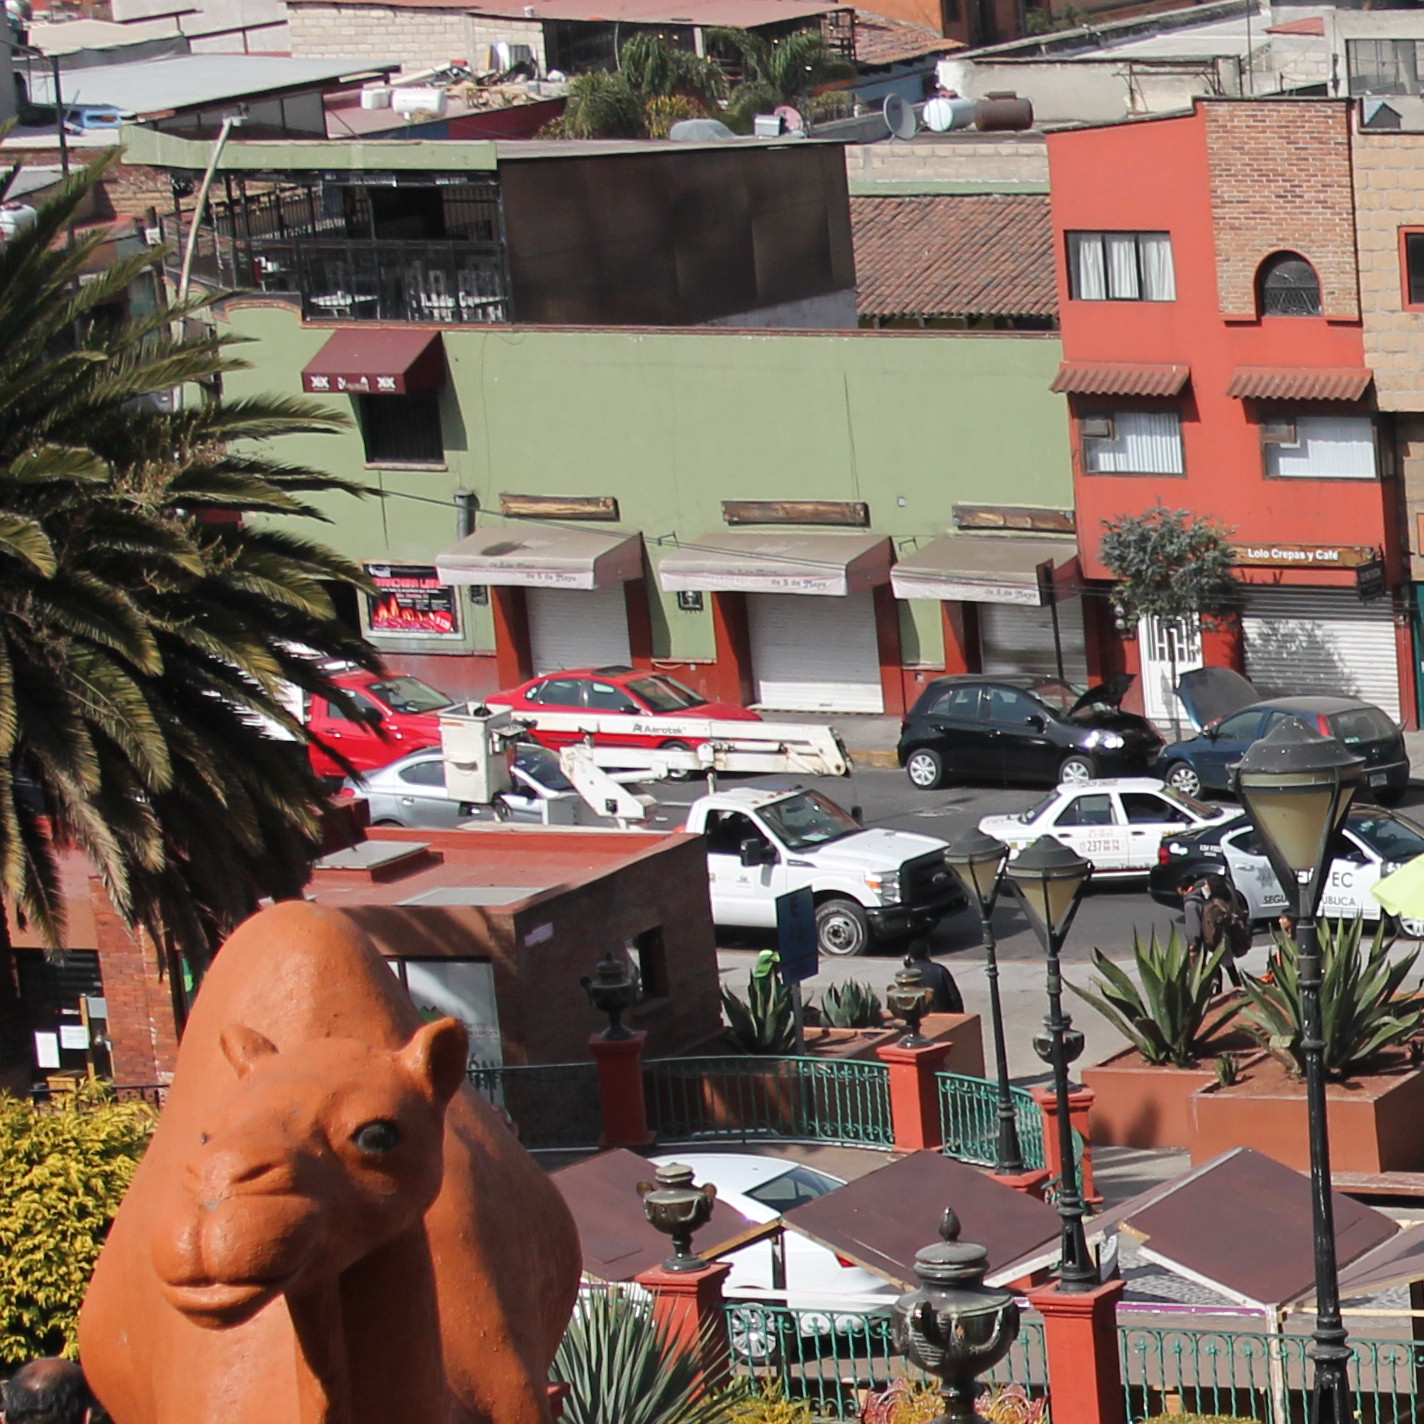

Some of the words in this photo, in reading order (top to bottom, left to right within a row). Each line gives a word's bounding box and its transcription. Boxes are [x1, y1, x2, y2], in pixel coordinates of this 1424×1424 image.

[1248, 549, 1270, 559] Lolo
[1271, 549, 1305, 560] Crepas
[1307, 552, 1314, 562] y
[1315, 549, 1338, 560] Café
